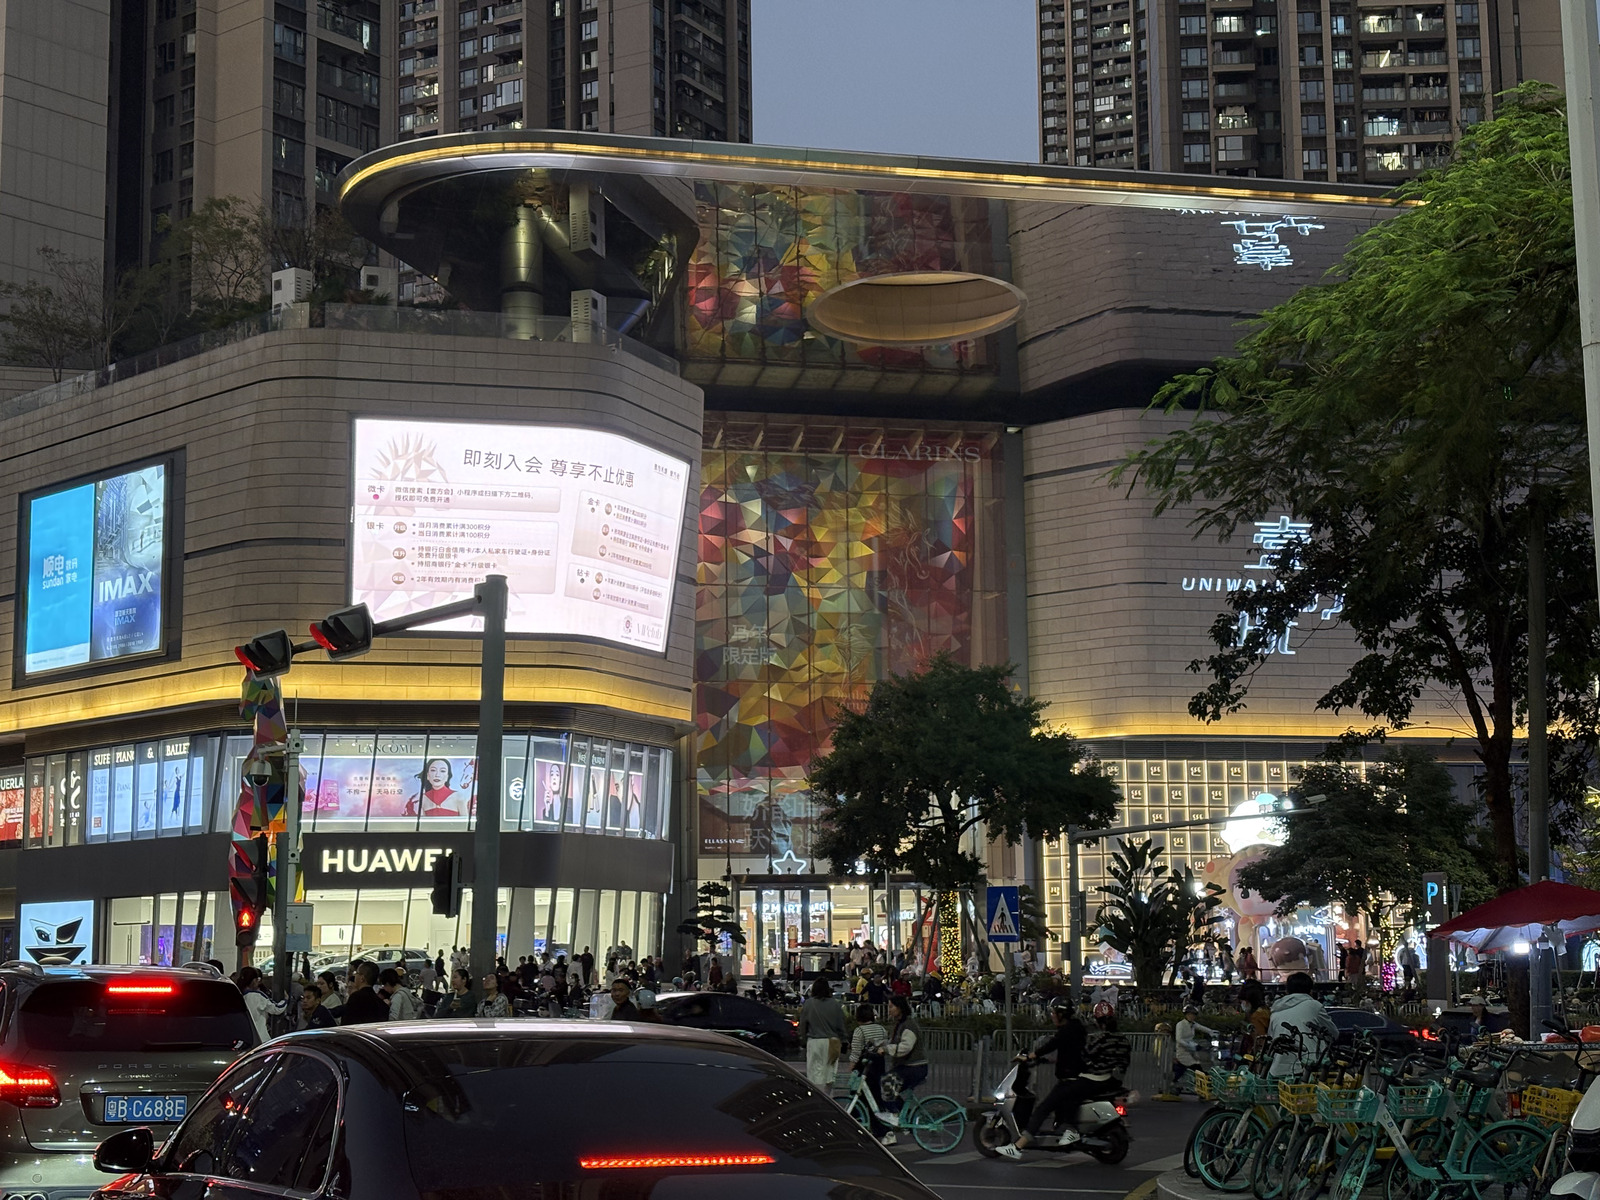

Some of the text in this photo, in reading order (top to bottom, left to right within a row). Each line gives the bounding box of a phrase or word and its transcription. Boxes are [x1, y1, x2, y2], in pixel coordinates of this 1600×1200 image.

[857, 442, 981, 463] CLARINS
[463, 448, 543, 475] 即刻入会
[549, 458, 635, 488] 尊享不止优惠
[367, 484, 385, 494] 微卡
[366, 521, 384, 531] 银卡
[43, 554, 65, 579] 顺电
[42, 575, 65, 590] sundan
[98, 571, 154, 603] IMAX
[114, 614, 136, 627] IMAX
[722, 646, 778, 666] 限定版
[94, 752, 111, 766] SUFE
[147, 746, 155, 759] &
[1427, 882, 1439, 905] P
